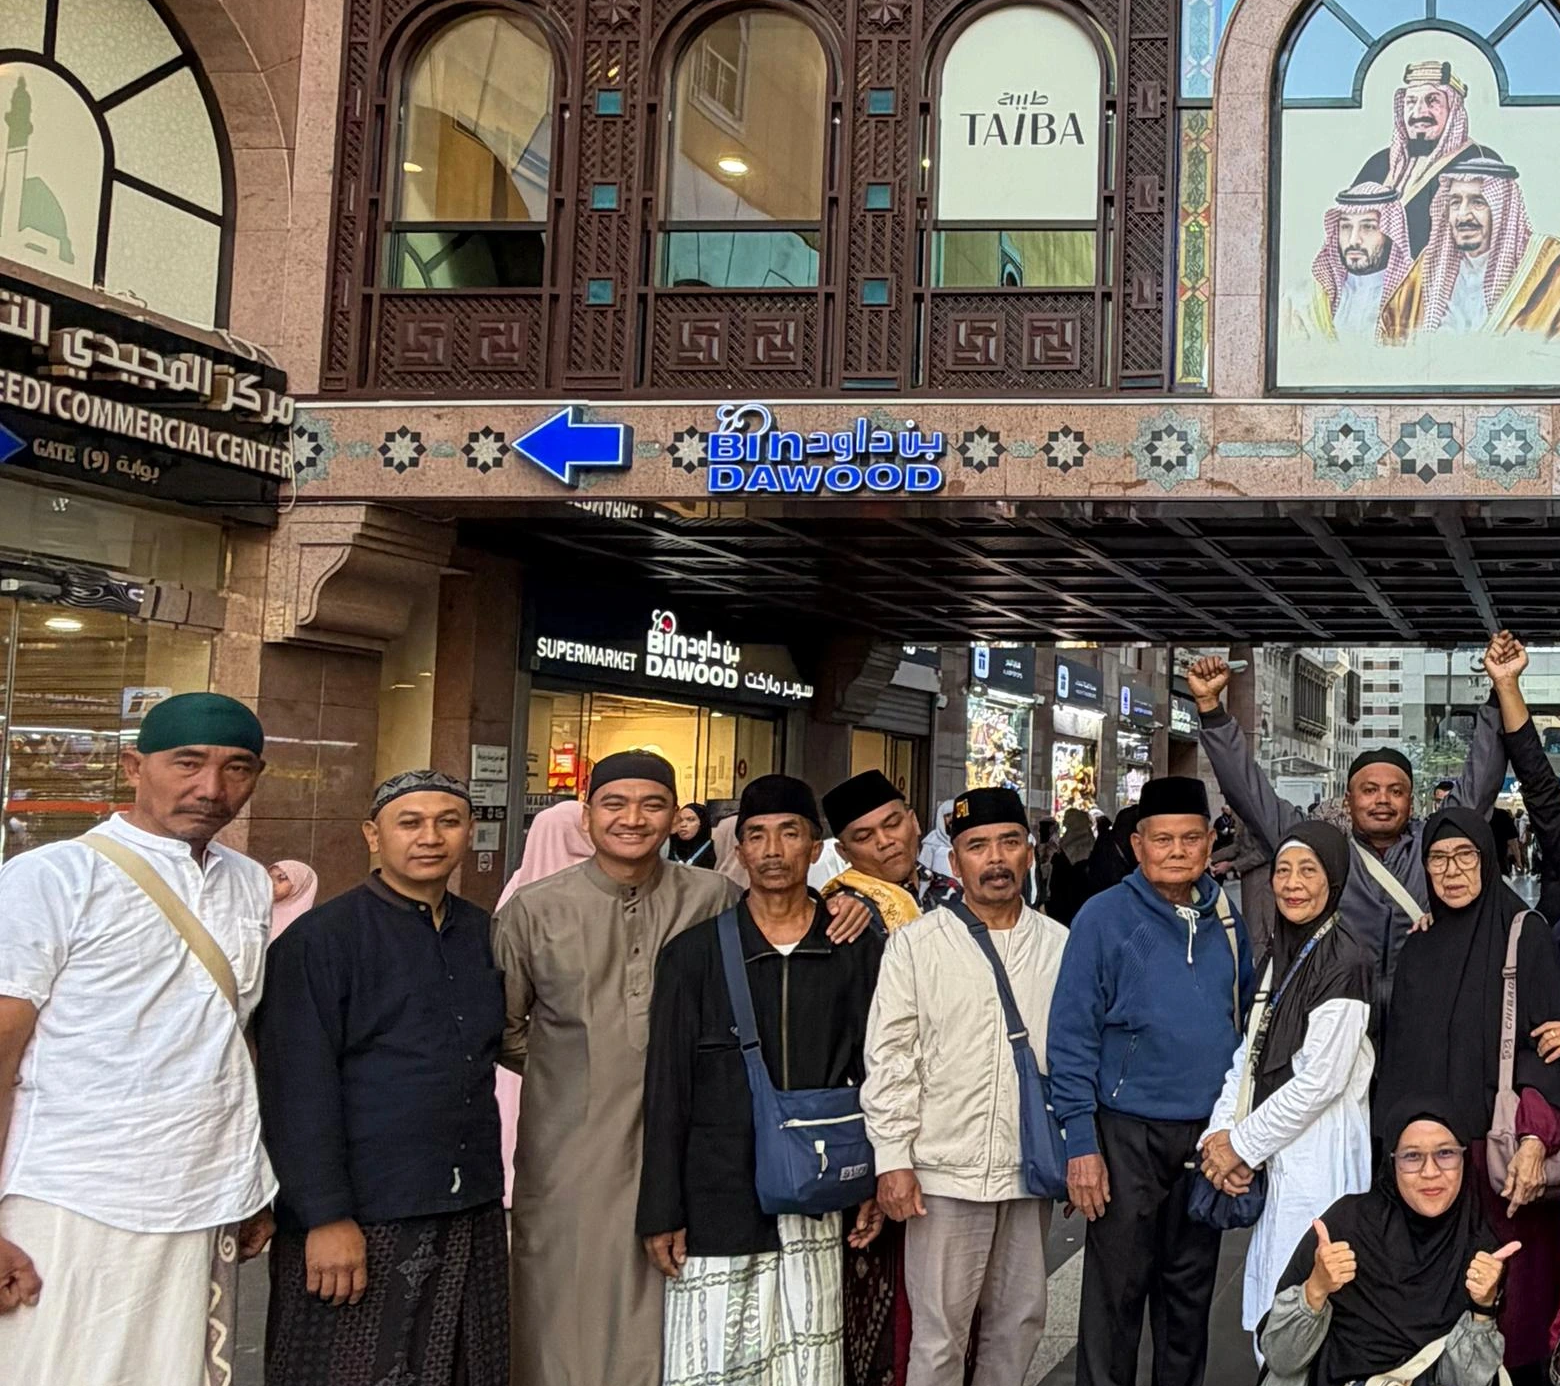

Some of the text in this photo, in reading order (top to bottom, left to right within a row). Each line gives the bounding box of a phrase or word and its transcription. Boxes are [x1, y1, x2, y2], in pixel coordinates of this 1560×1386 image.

[997, 90, 1049, 110] طيبة
[959, 112, 1085, 146] TAIBA
[62, 329, 213, 397] المجيدي
[220, 366, 295, 426] مركز
[33, 437, 76, 463] GATE
[56, 386, 214, 457] COMMERCIAL
[215, 433, 294, 480] CENTER
[806, 417, 943, 462] بن داود
[116, 454, 160, 484] بوابة
[708, 463, 943, 493] DAWOOD
[536, 636, 638, 672] SUPERMARKET
[645, 654, 739, 689] DAWOOD
[744, 671, 814, 701] سوبر ماركت
